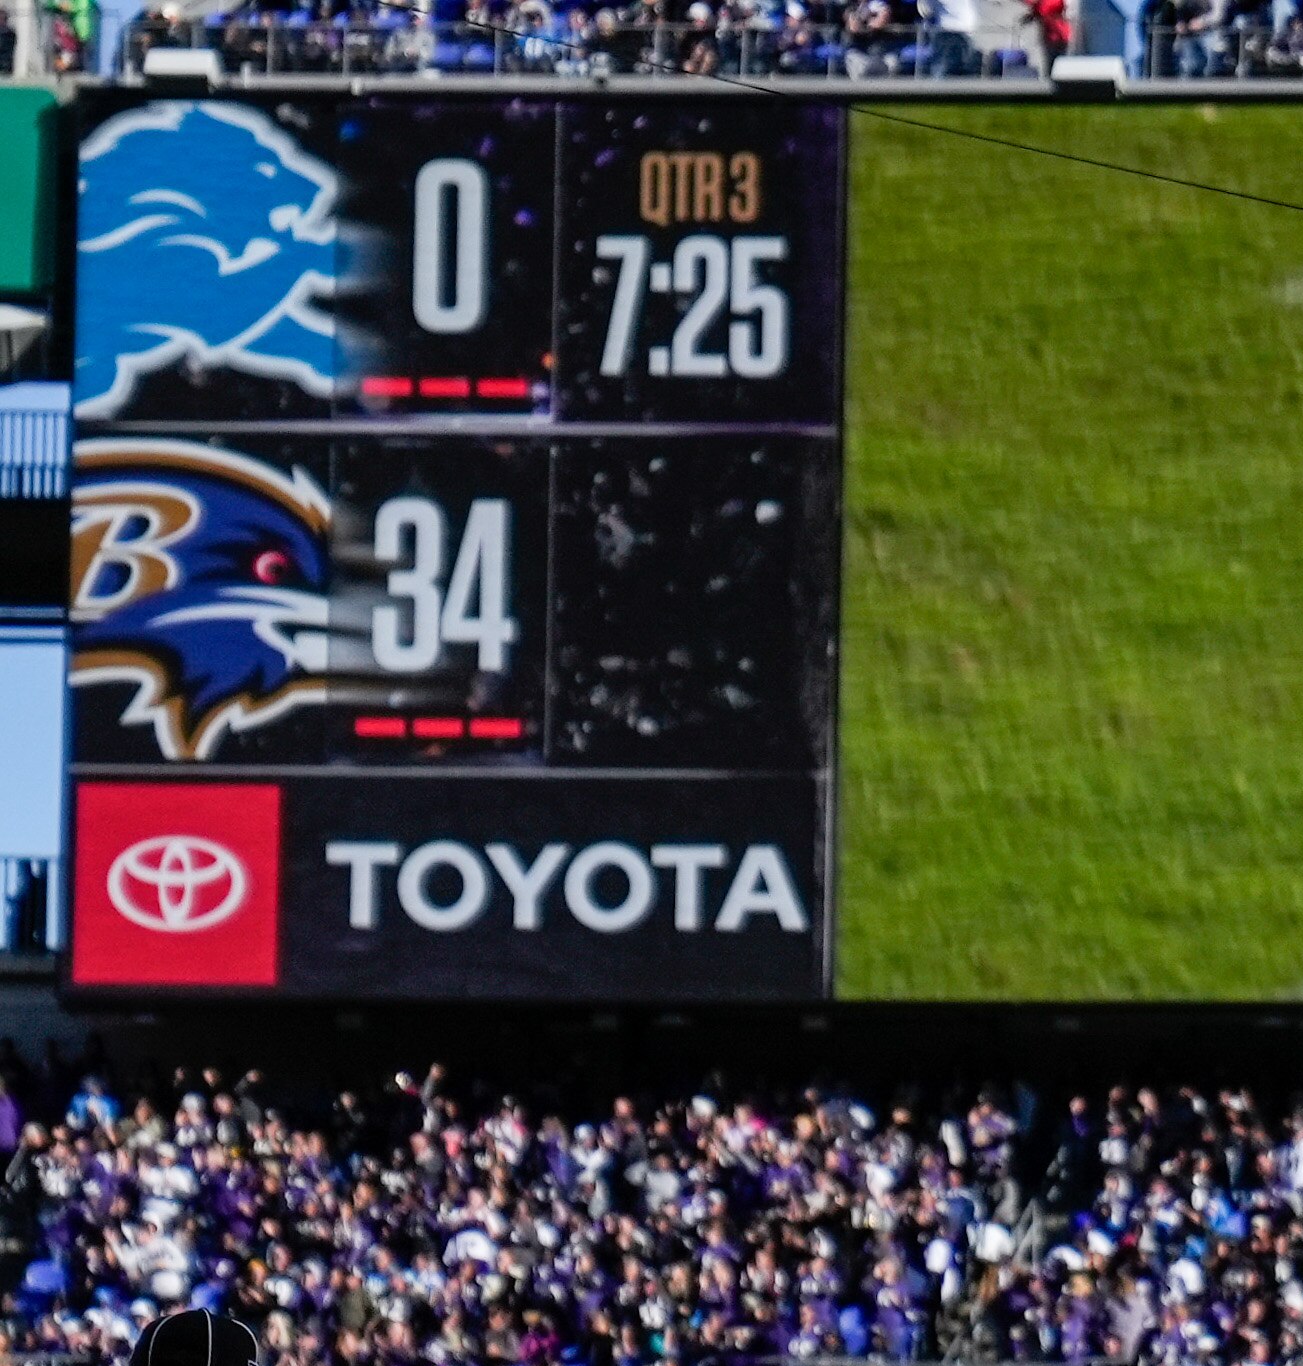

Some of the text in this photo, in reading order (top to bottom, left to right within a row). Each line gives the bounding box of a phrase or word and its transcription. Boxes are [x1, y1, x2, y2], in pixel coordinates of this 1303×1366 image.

[413, 158, 488, 333] 0
[640, 152, 761, 225] QTR 3
[598, 236, 790, 378] 7:25
[373, 498, 516, 673] 34
[326, 840, 809, 932] TOYOTA
